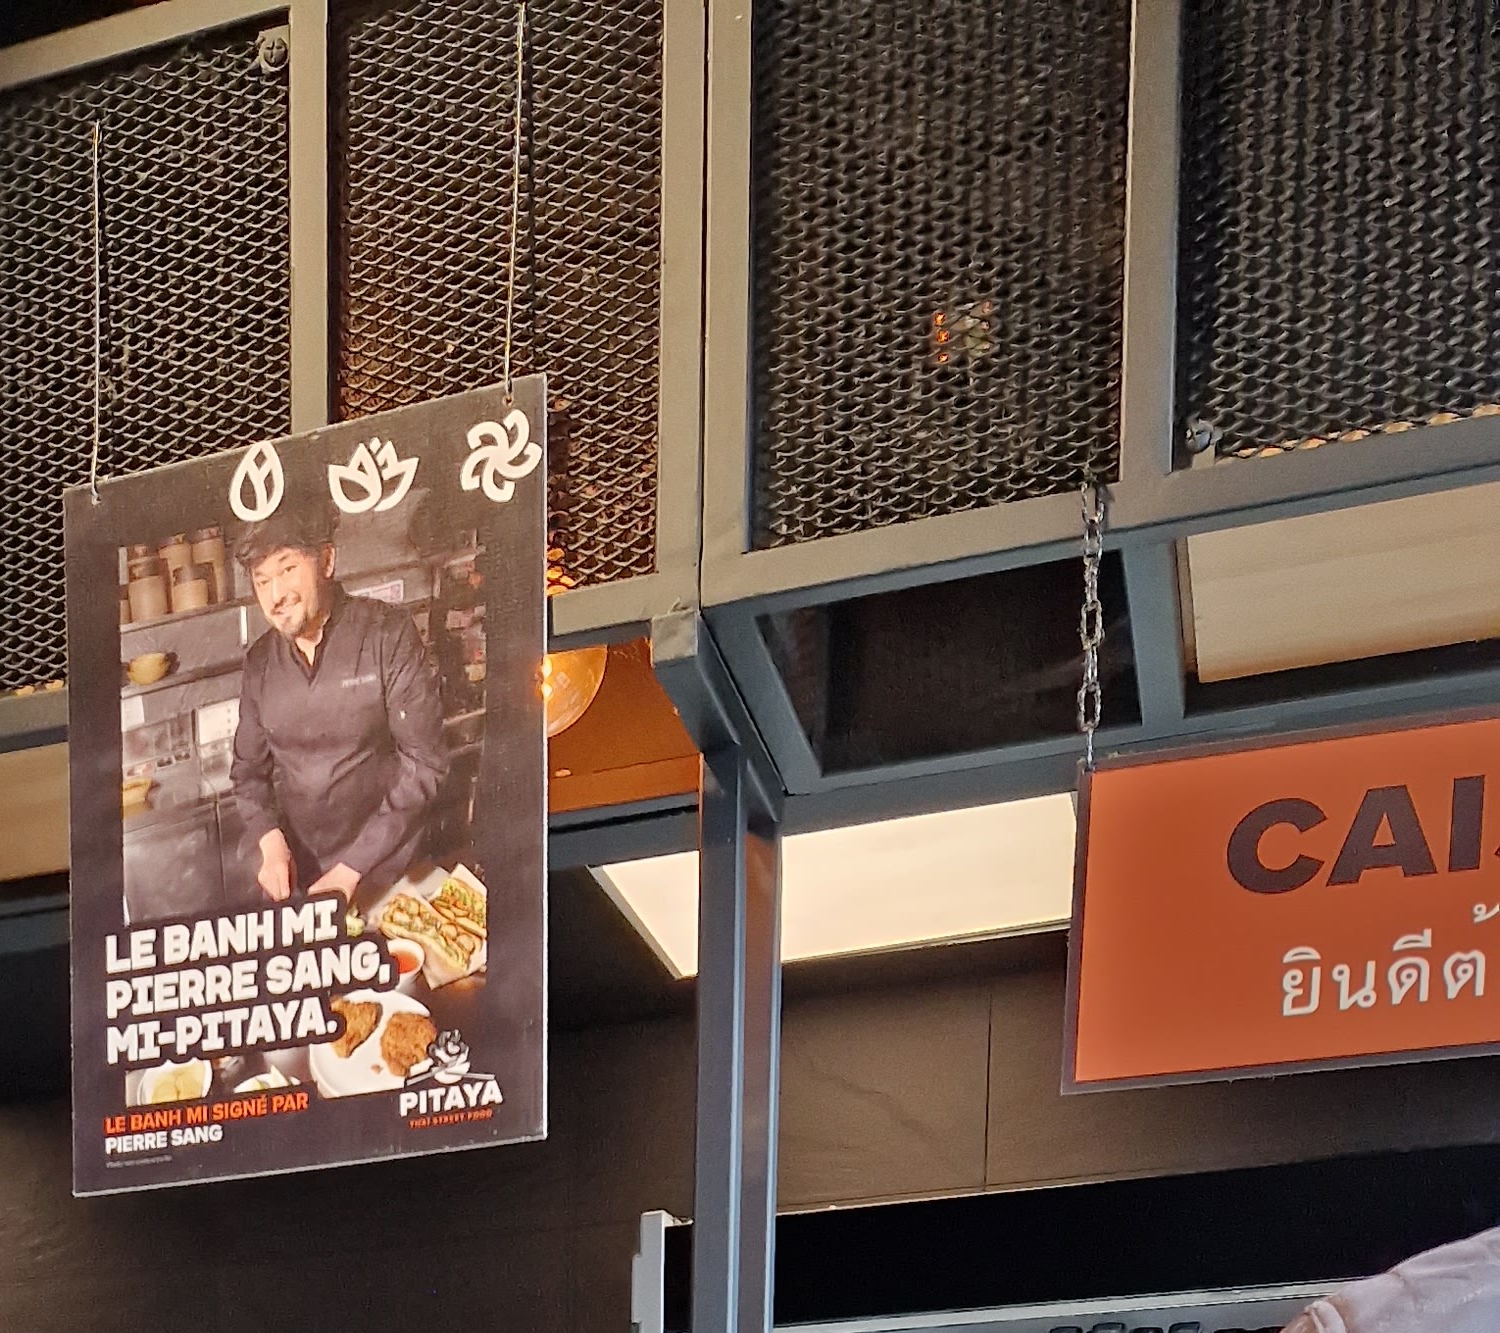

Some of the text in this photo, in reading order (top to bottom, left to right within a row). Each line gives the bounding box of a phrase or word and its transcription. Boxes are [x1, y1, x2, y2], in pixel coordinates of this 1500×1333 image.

[1227, 775, 1500, 894] CAI
[105, 899, 338, 974] LE BANH MI
[106, 941, 391, 1018] PIERRE SANG,
[106, 996, 338, 1064] MI-PITAYA.
[105, 1092, 309, 1135] LE BANH MI SIGNÉ PAR
[399, 1079, 503, 1117] PITAYA
[105, 1125, 223, 1154] PIERRE SANG
